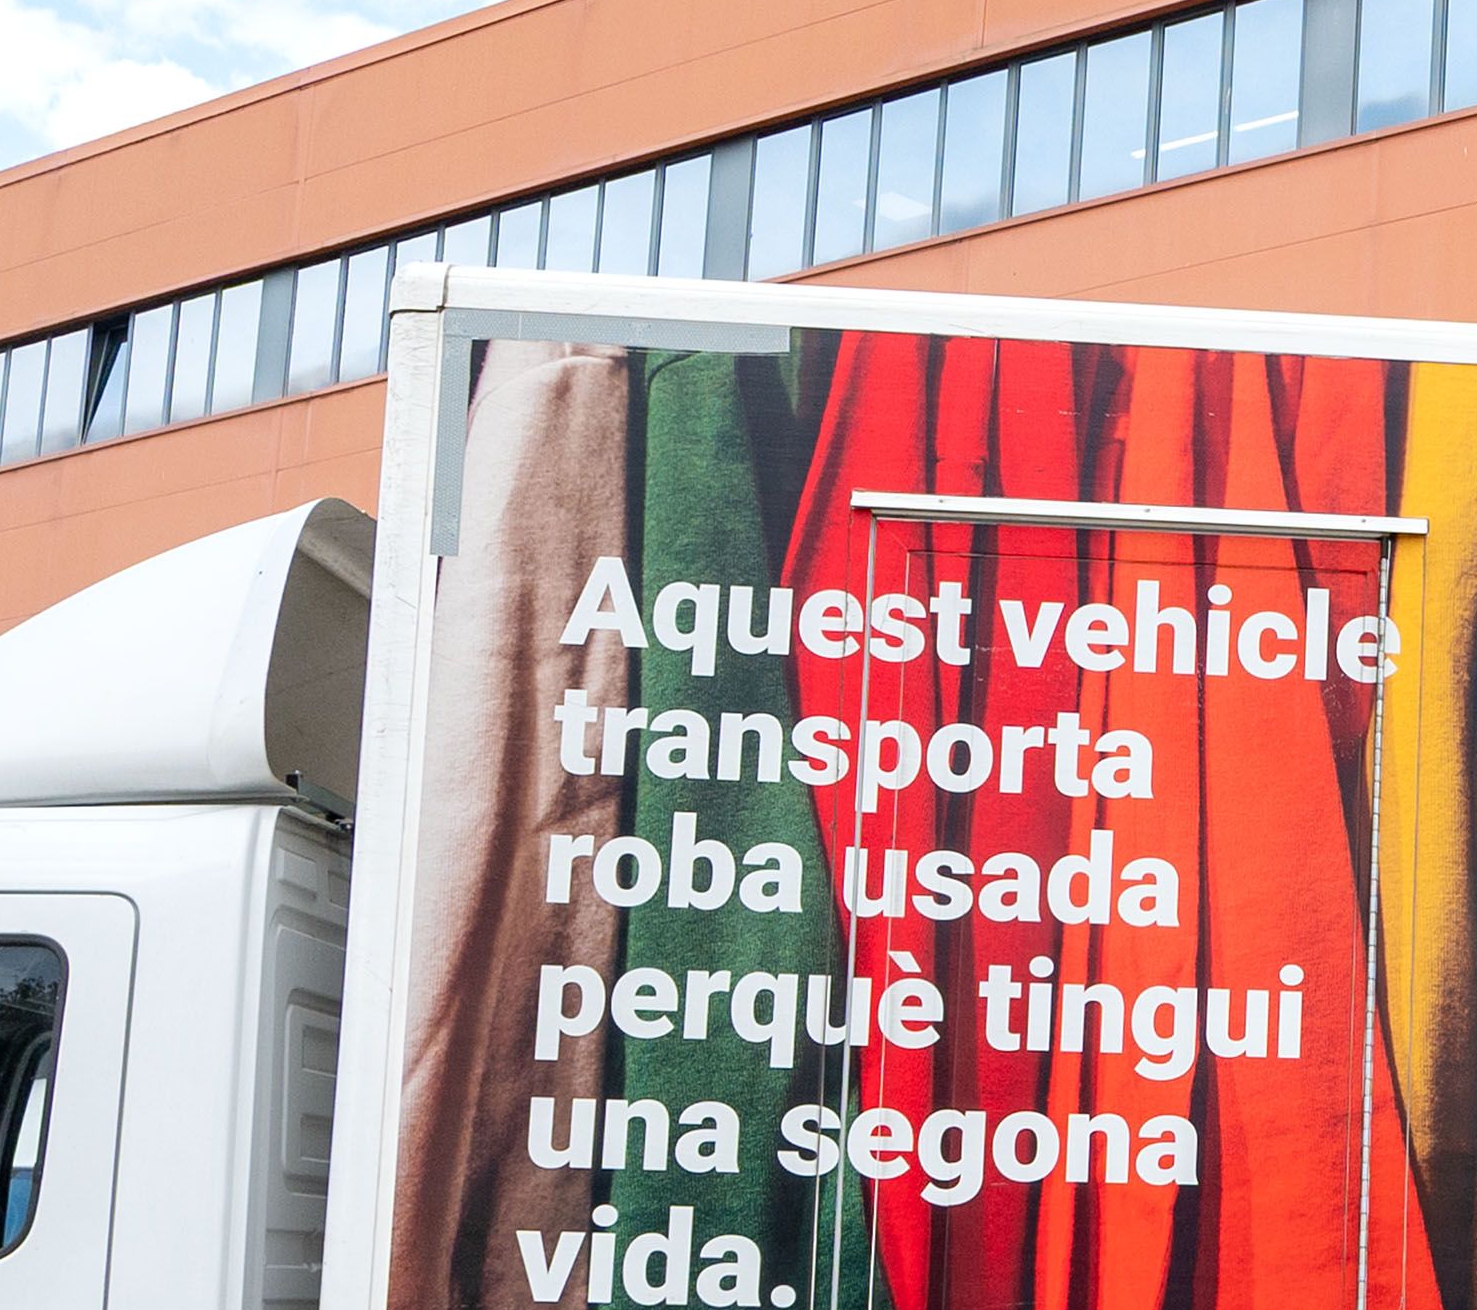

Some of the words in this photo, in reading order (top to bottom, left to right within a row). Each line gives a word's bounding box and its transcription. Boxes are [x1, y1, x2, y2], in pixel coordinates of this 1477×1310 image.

[560, 555, 973, 676] Aquest
[1001, 580, 1400, 684] vehicle
[554, 688, 1154, 812] transporta
[545, 812, 802, 913] roba
[842, 831, 1179, 927] usada
[532, 951, 943, 1068] perquè
[978, 956, 1304, 1079] tingui
[526, 1096, 738, 1173] una
[778, 1103, 1198, 1206] segona
[516, 1204, 797, 1307] vida.
